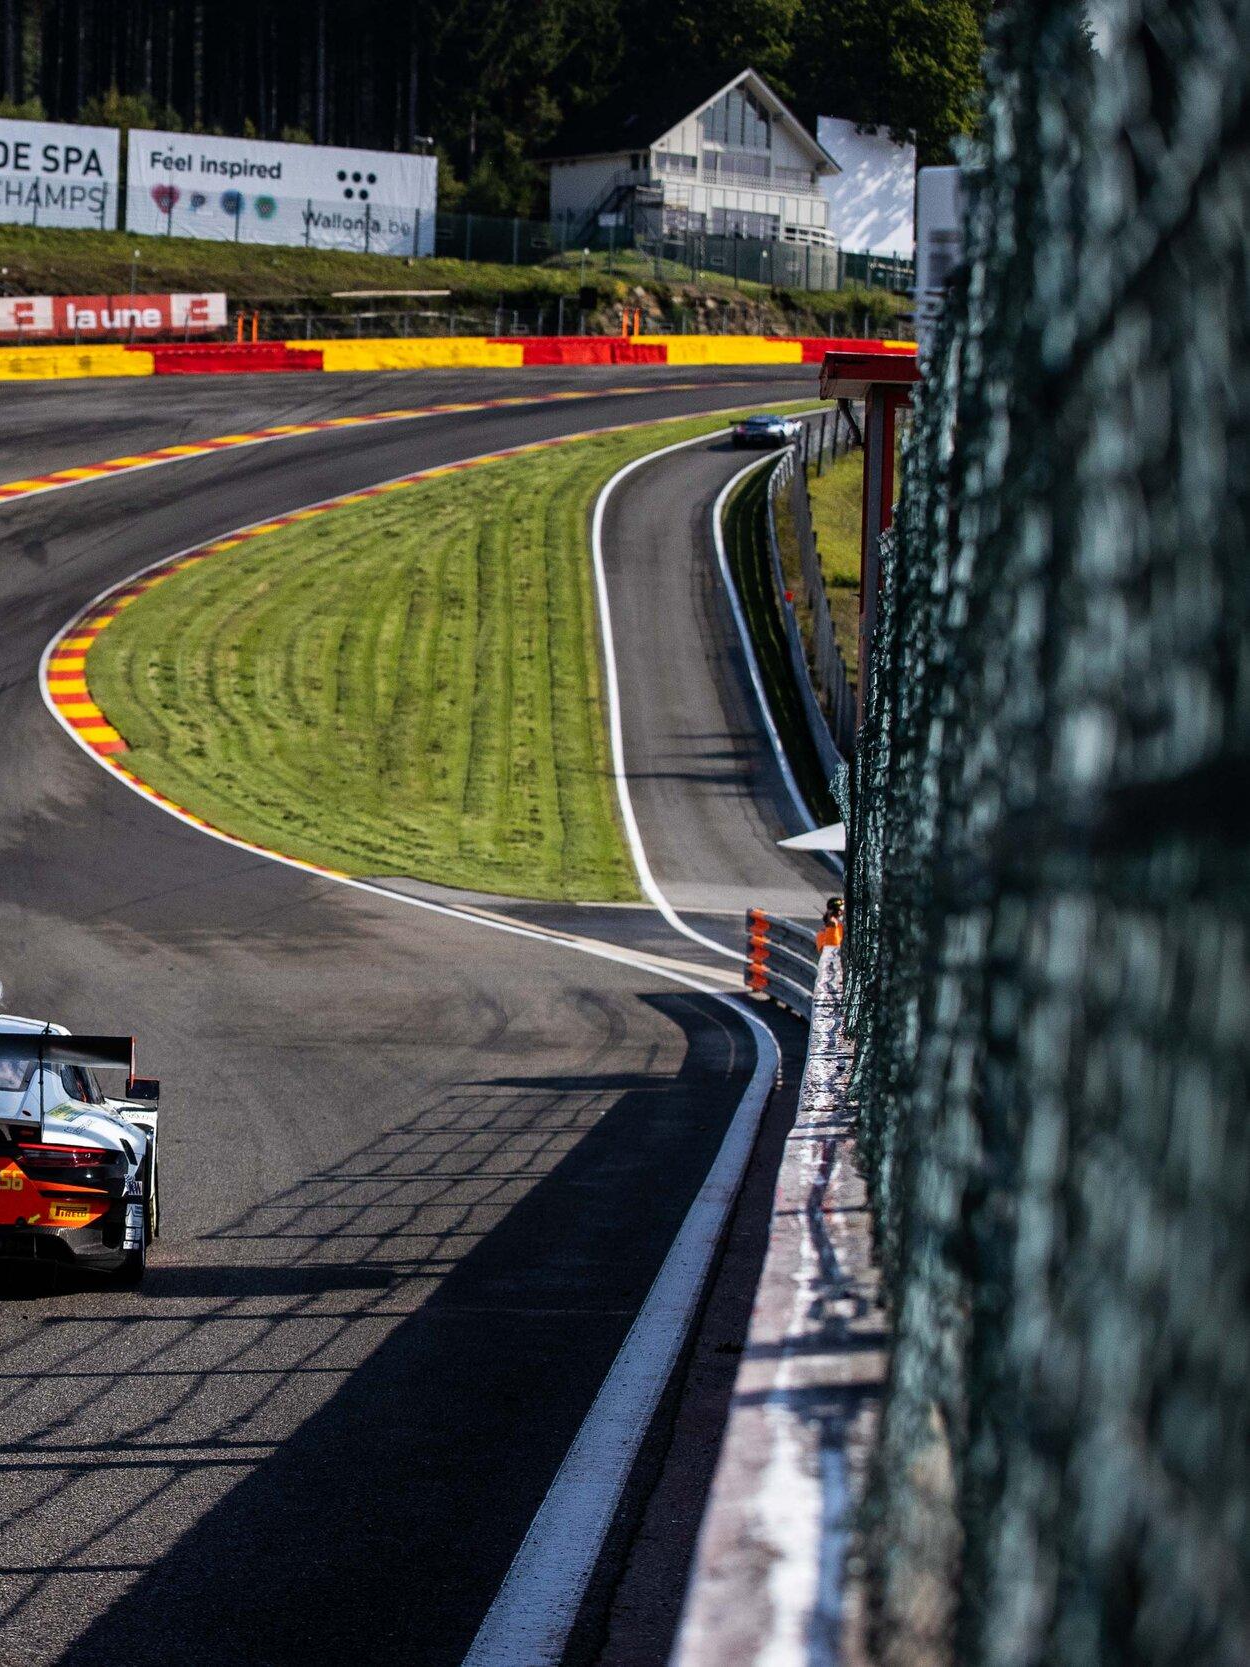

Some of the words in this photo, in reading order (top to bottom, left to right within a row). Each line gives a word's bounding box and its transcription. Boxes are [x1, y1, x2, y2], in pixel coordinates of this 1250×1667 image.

[42, 144, 104, 177] SPA
[151, 151, 192, 171] Feel
[201, 155, 282, 179] inspired
[302, 209, 411, 236] Wallona.be
[0, 1169, 24, 1191] 56
